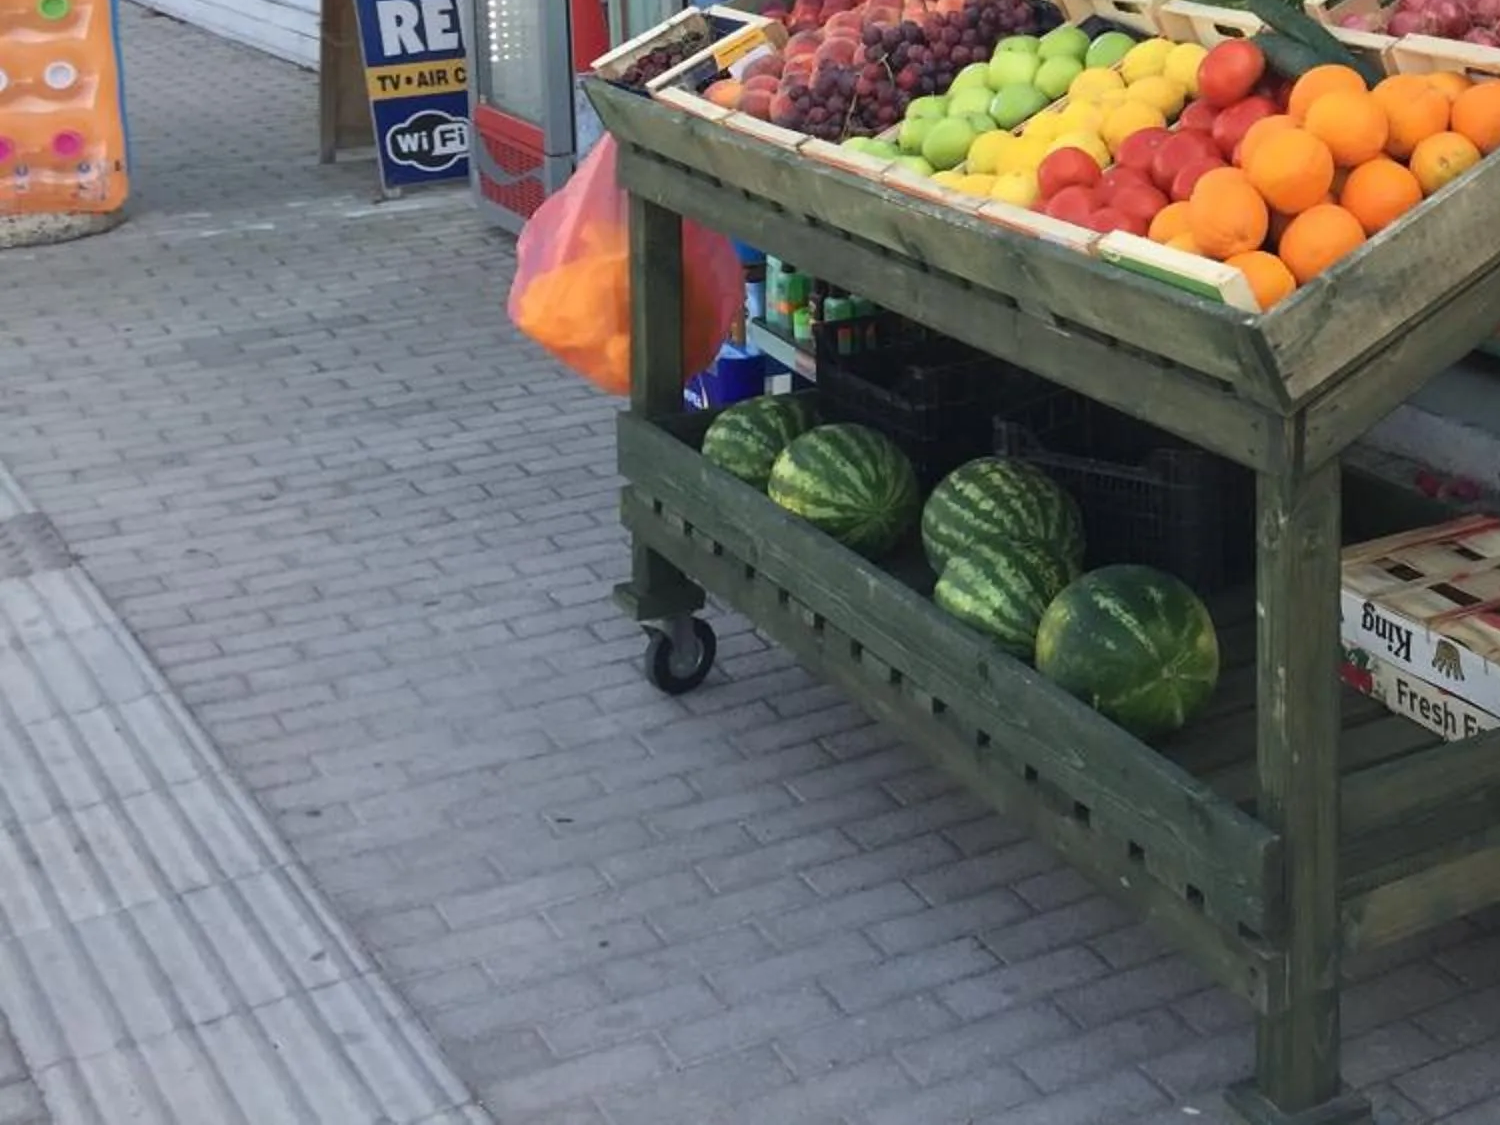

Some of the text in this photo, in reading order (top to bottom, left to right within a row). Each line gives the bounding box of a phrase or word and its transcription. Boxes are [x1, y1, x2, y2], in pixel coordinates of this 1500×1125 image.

[377, 66, 467, 92] TV AIR C
[1361, 601, 1414, 664] King
[1396, 678, 1457, 735] Fresh
